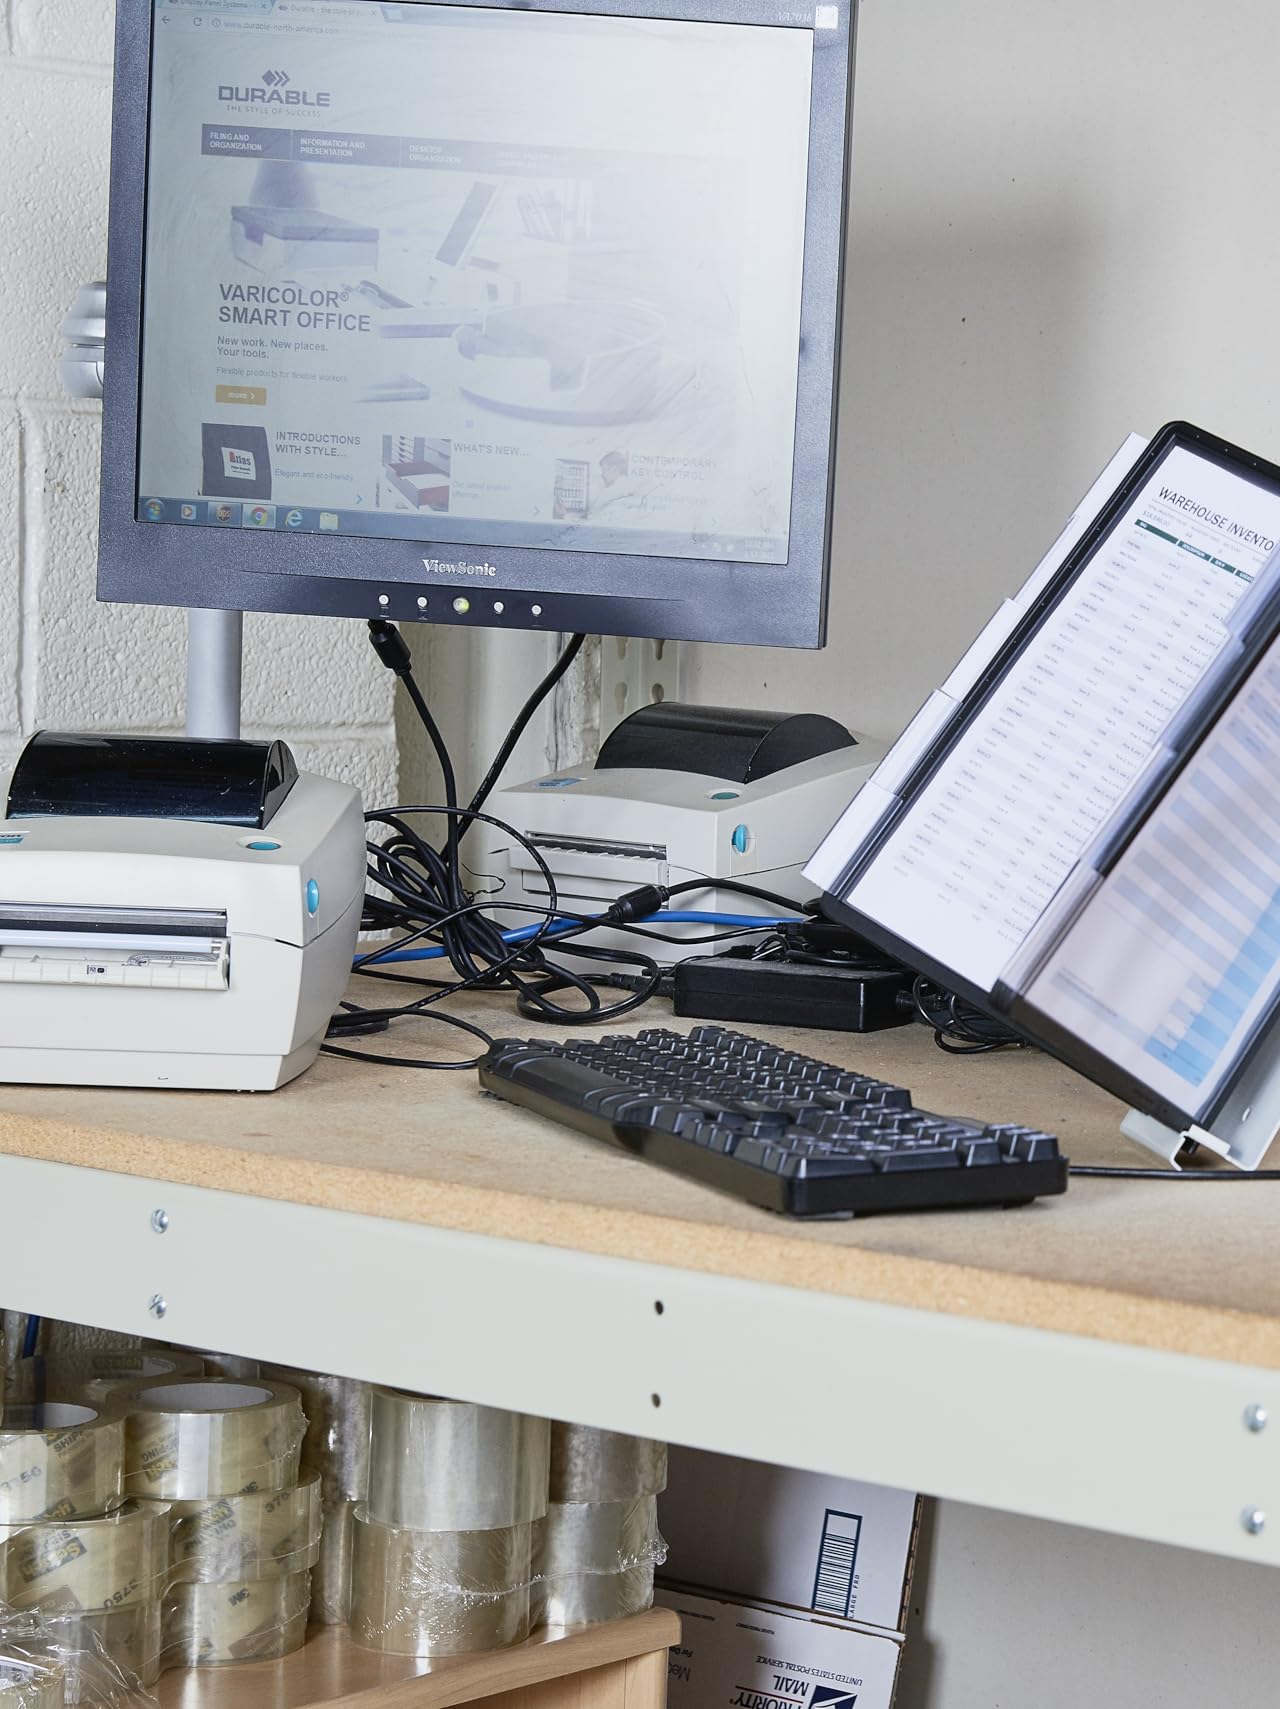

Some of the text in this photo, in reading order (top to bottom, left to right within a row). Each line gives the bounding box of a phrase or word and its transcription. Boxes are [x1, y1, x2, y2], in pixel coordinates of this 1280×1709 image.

[218, 86, 331, 107] DURABLE
[210, 132, 250, 142] FILING AND
[300, 138, 366, 150] INFORMATION AND
[209, 141, 263, 152] ORGANIZATION
[300, 147, 353, 158] PRESENTATION
[218, 306, 371, 332] SMART OFFICE
[217, 335, 329, 353] New work. New places.
[217, 347, 270, 359] Your tools.
[275, 431, 361, 446] INTRODUCTIONS
[275, 444, 347, 458] WITH STYLE...
[453, 442, 492, 455] WHAT'S
[1158, 486, 1229, 530] WAREHOUSE
[1227, 521, 1275, 552] INVENTO
[422, 558, 497, 577] ViewSonic
[755, 1655, 863, 1687] UNITED STATES POSTAL SERVICE
[772, 1674, 810, 1697] MAIL
